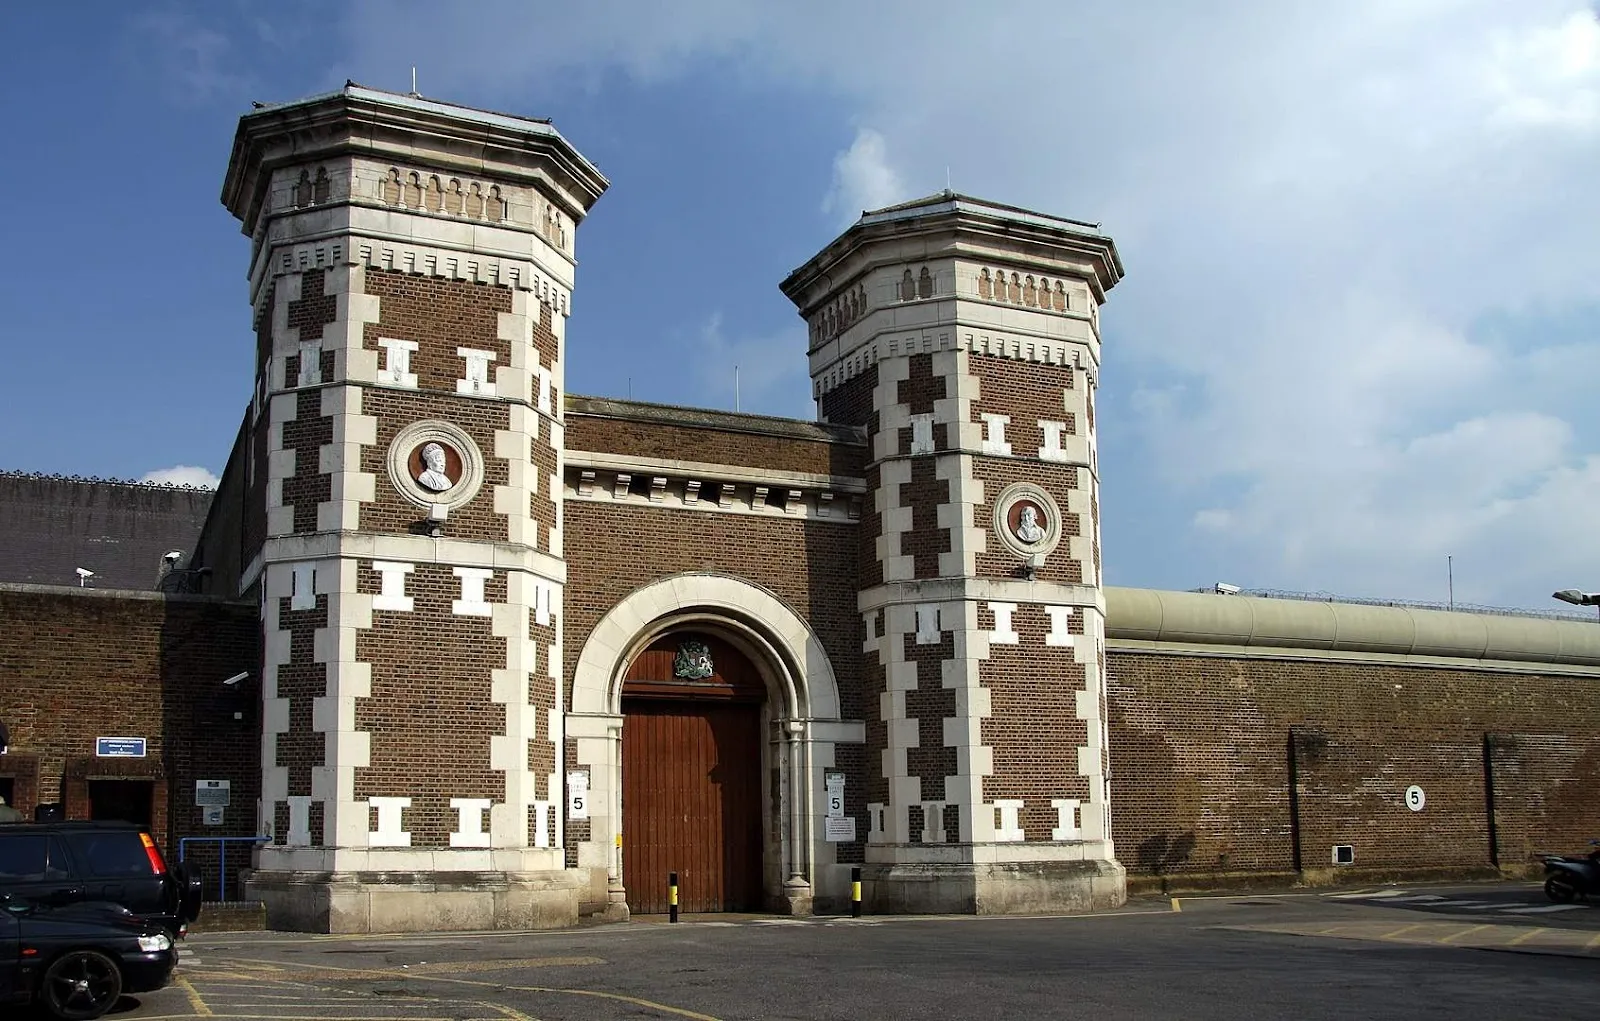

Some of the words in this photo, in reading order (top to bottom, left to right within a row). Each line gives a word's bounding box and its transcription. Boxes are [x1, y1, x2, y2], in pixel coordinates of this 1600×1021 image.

[574, 797, 583, 810] 5
[831, 797, 840, 810] 5
[1411, 791, 1419, 804] 5
